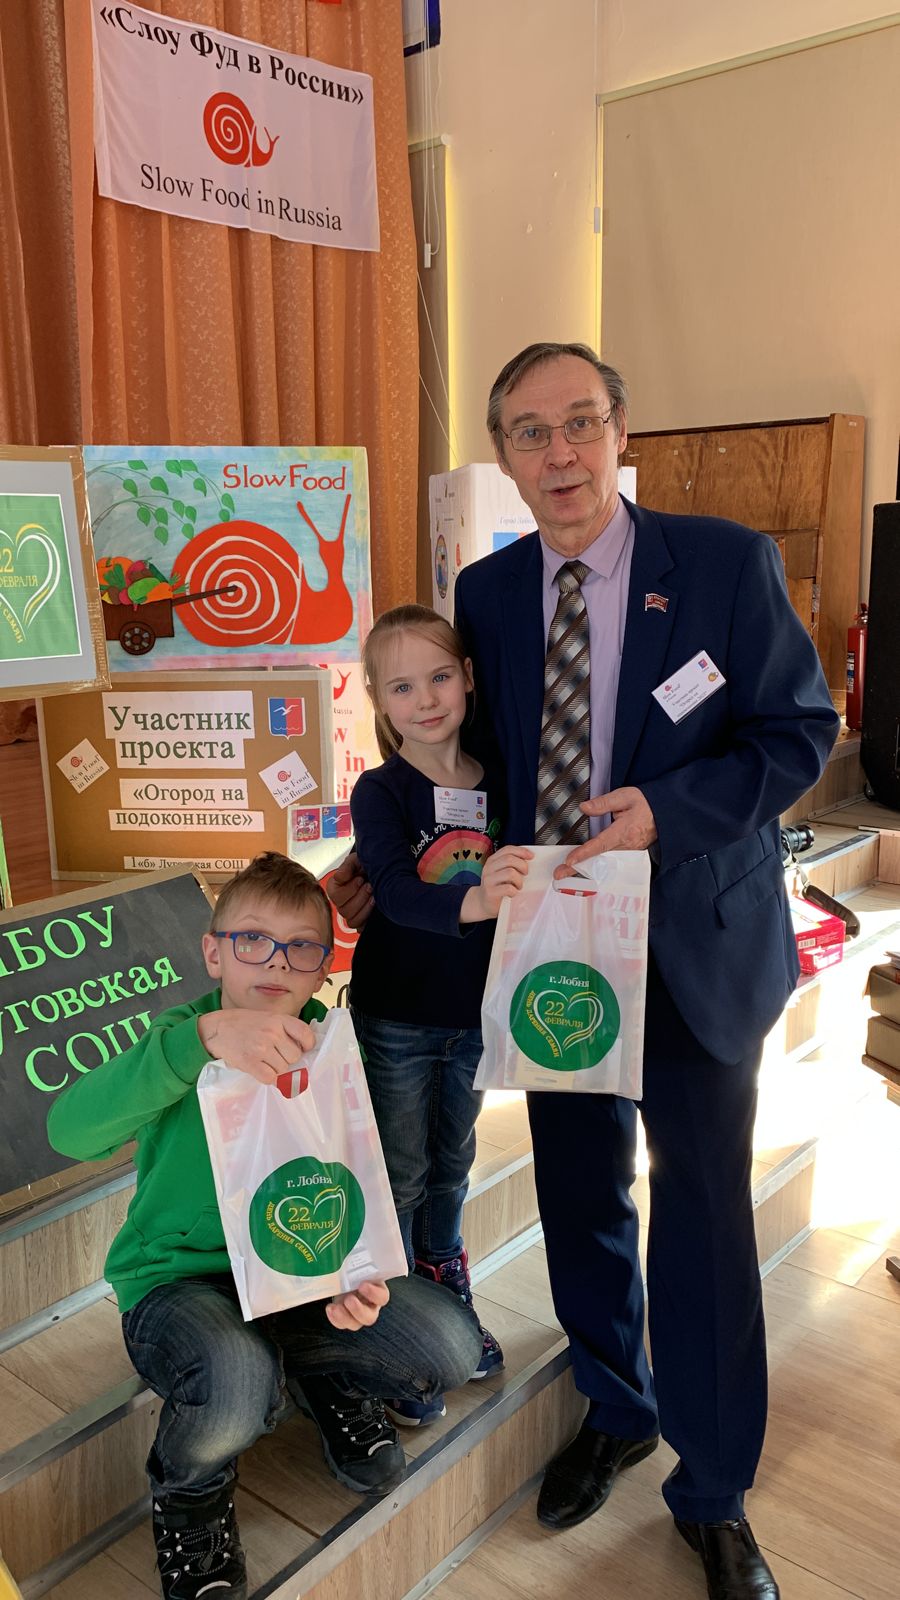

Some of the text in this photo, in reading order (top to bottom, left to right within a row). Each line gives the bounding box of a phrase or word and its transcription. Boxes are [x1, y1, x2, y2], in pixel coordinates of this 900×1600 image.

[100, 6, 364, 106] «Слоу Фуд в России»
[140, 163, 342, 231] Slow Food in Russia
[223, 463, 346, 491] Slow Food
[108, 706, 251, 731] Участник
[119, 740, 236, 766] проекта
[133, 783, 245, 806] «Огород на
[116, 811, 253, 828] подоконнике»
[411, 829, 434, 858] look
[558, 975, 590, 988] Лобня
[544, 1000, 565, 1017] 22
[544, 1016, 584, 1029] ФЕВРАЛЯ
[297, 1173, 333, 1187] Лобня
[288, 1206, 311, 1223] 22
[290, 1220, 335, 1232] ФЕВРАЛЯ
